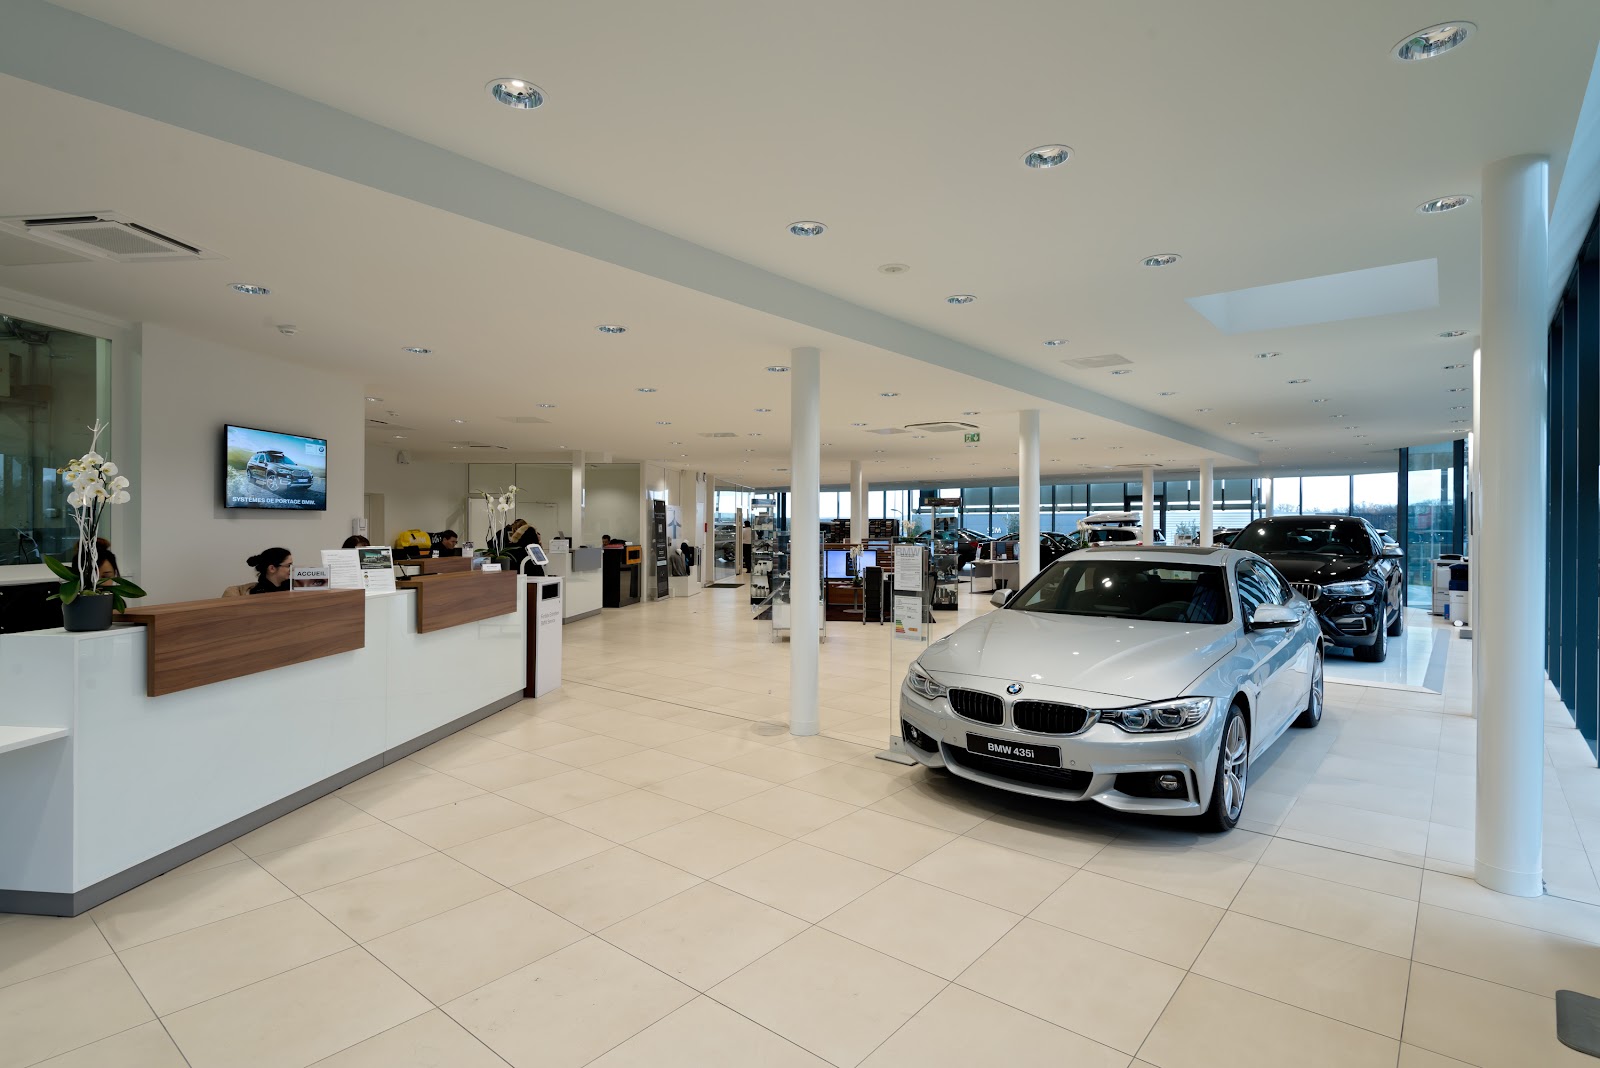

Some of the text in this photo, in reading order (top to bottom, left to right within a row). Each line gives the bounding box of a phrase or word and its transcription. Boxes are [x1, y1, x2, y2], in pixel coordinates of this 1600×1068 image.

[896, 547, 920, 556] BMW
[987, 742, 1035, 758] BMW 435i
